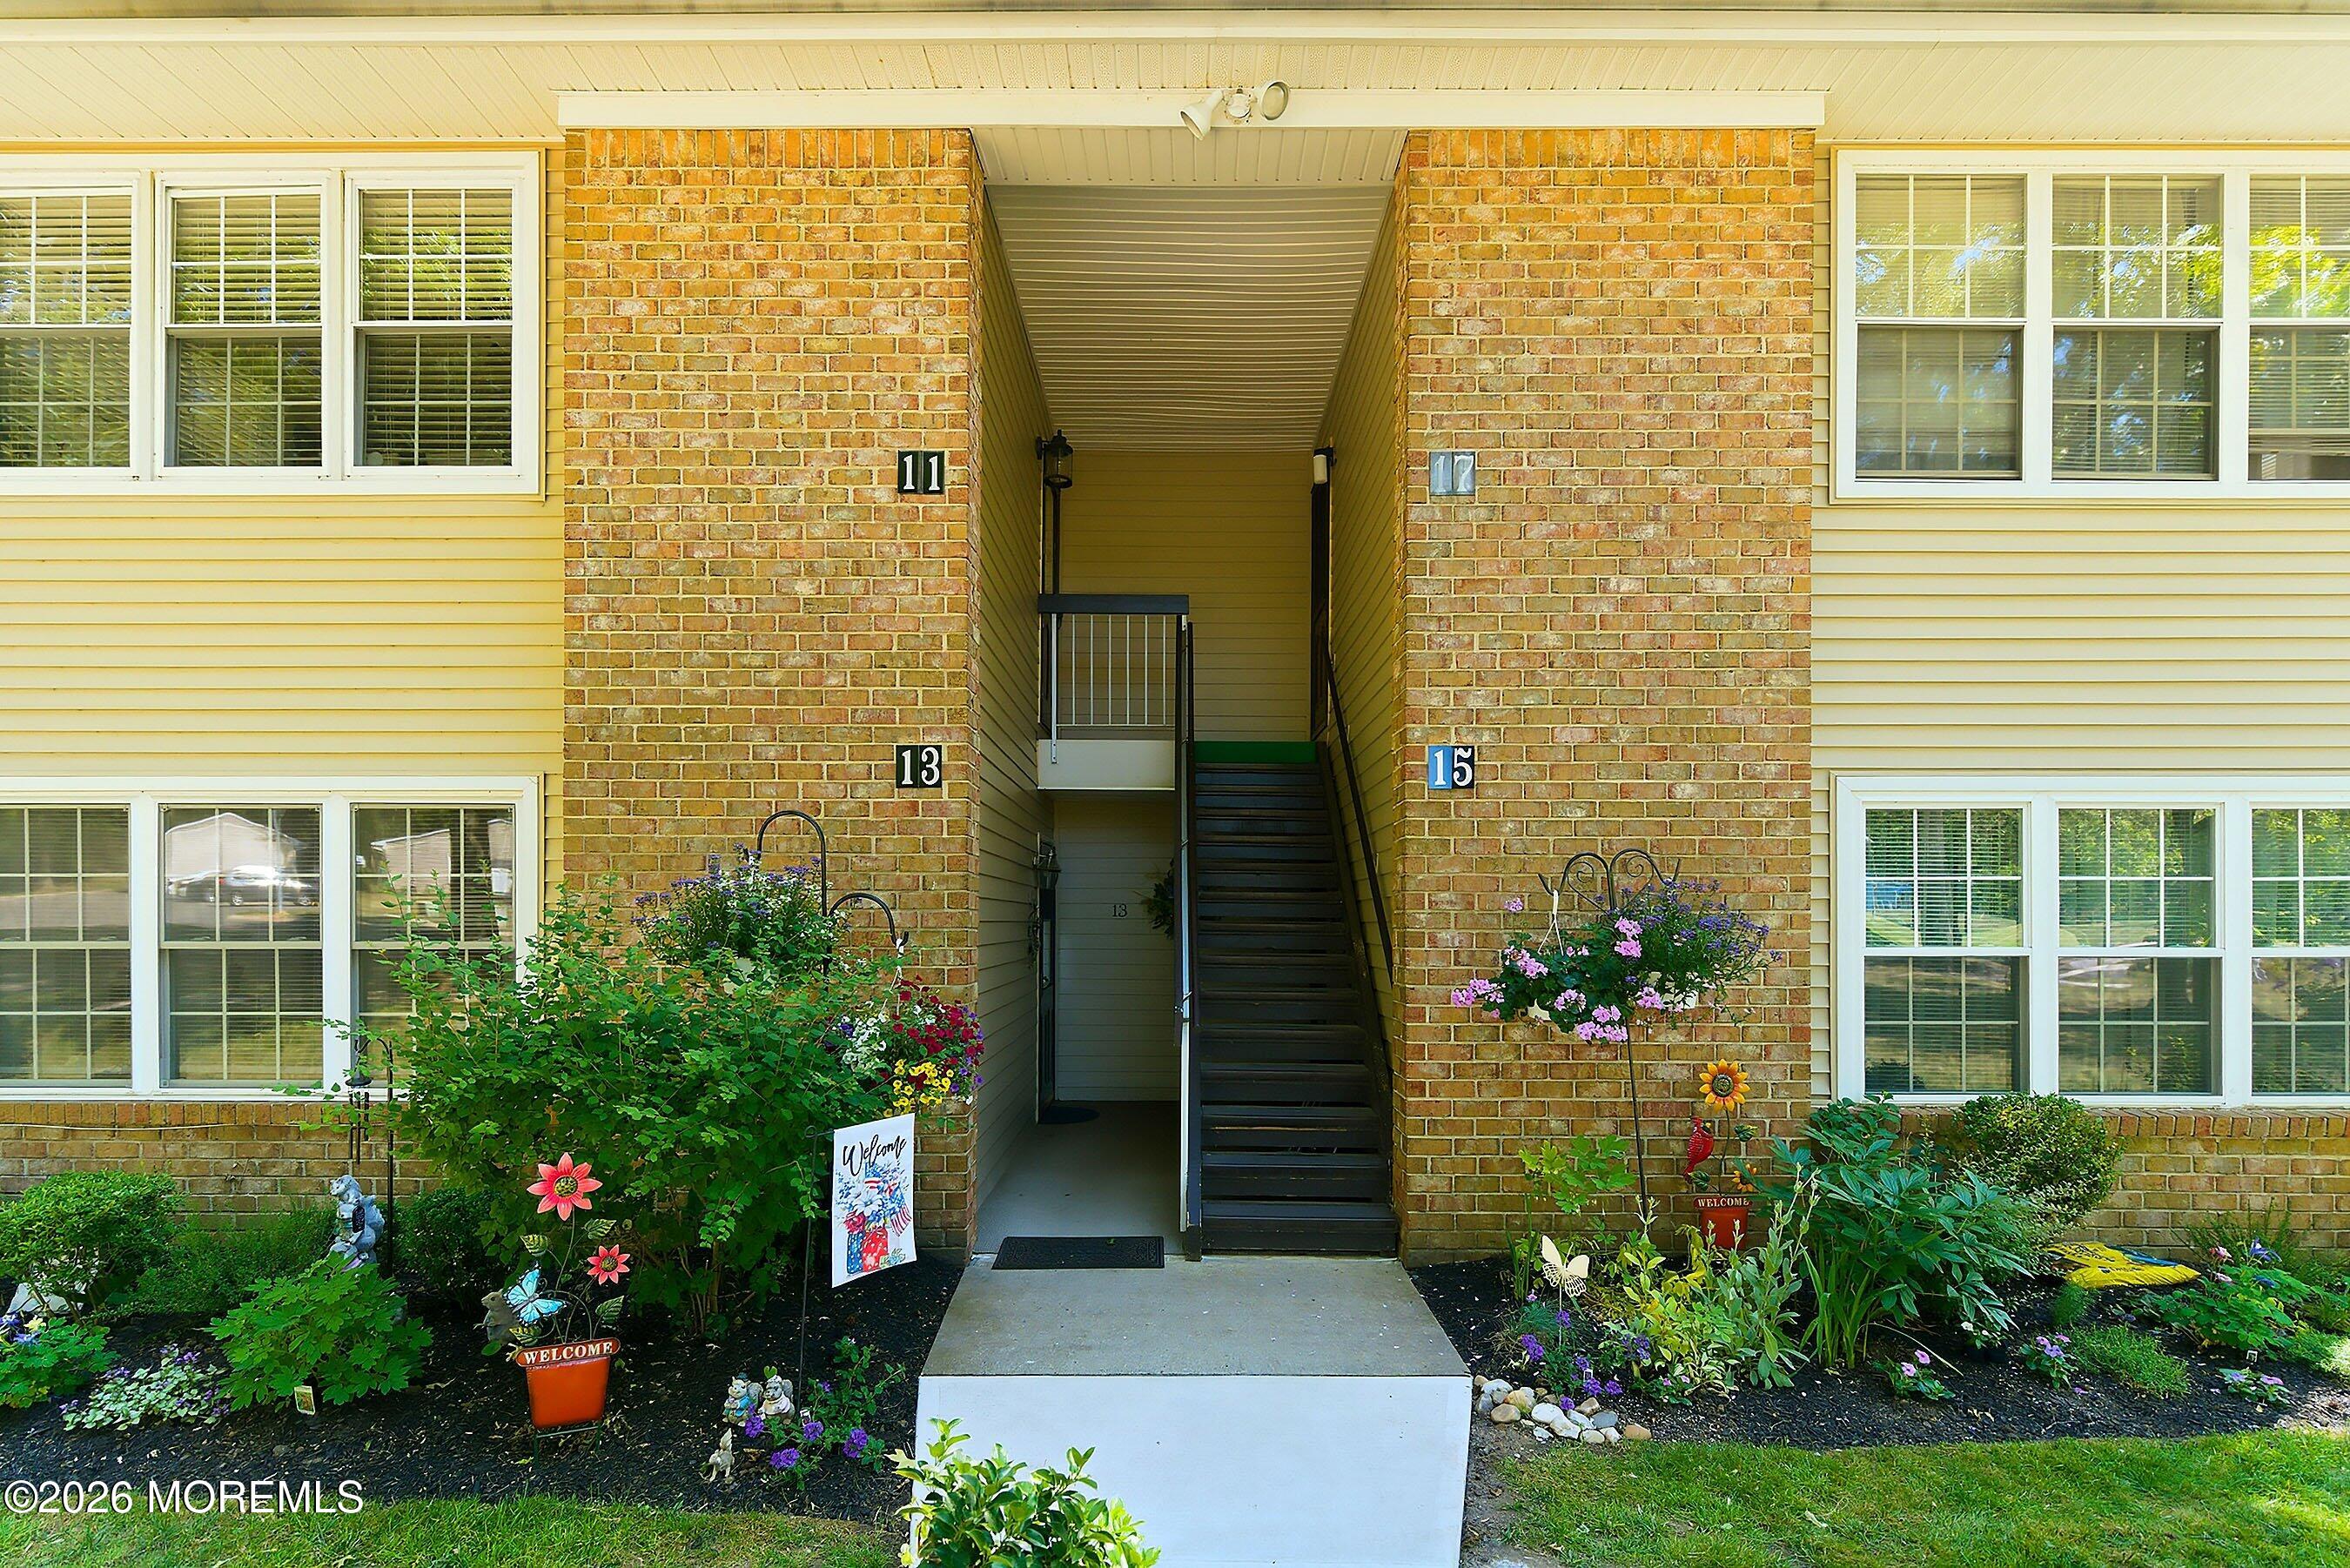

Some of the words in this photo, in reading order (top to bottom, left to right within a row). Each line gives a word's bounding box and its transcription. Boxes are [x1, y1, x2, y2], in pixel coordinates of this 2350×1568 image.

[903, 454, 941, 491] 11
[1434, 455, 1474, 493] 17
[901, 747, 940, 785] 13
[1434, 747, 1473, 787] 15
[1112, 903, 1128, 918] 13
[843, 1134, 907, 1176] Welcome
[523, 1342, 613, 1364] WELCOME
